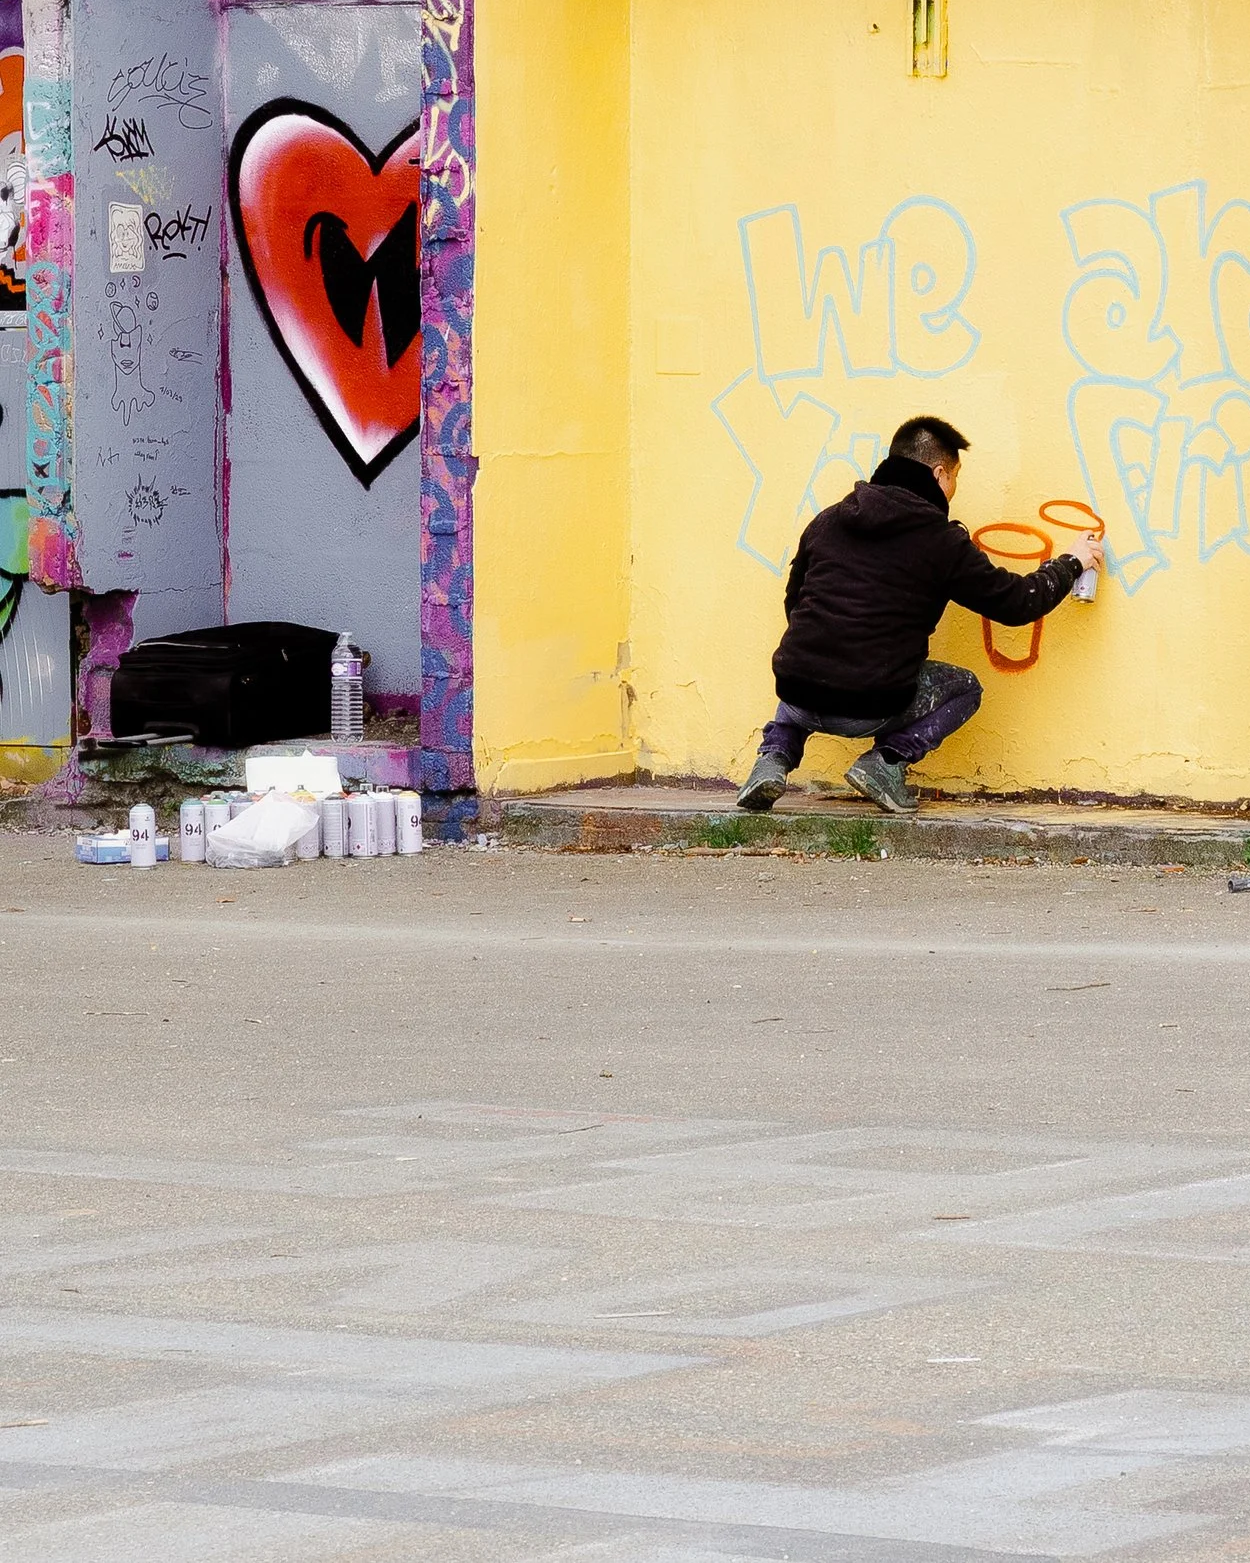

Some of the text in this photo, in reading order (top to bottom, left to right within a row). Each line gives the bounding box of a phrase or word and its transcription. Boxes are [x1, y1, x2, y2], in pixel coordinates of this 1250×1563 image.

[738, 194, 982, 385] We
[132, 829, 150, 842] 94
[185, 823, 203, 836] 94
